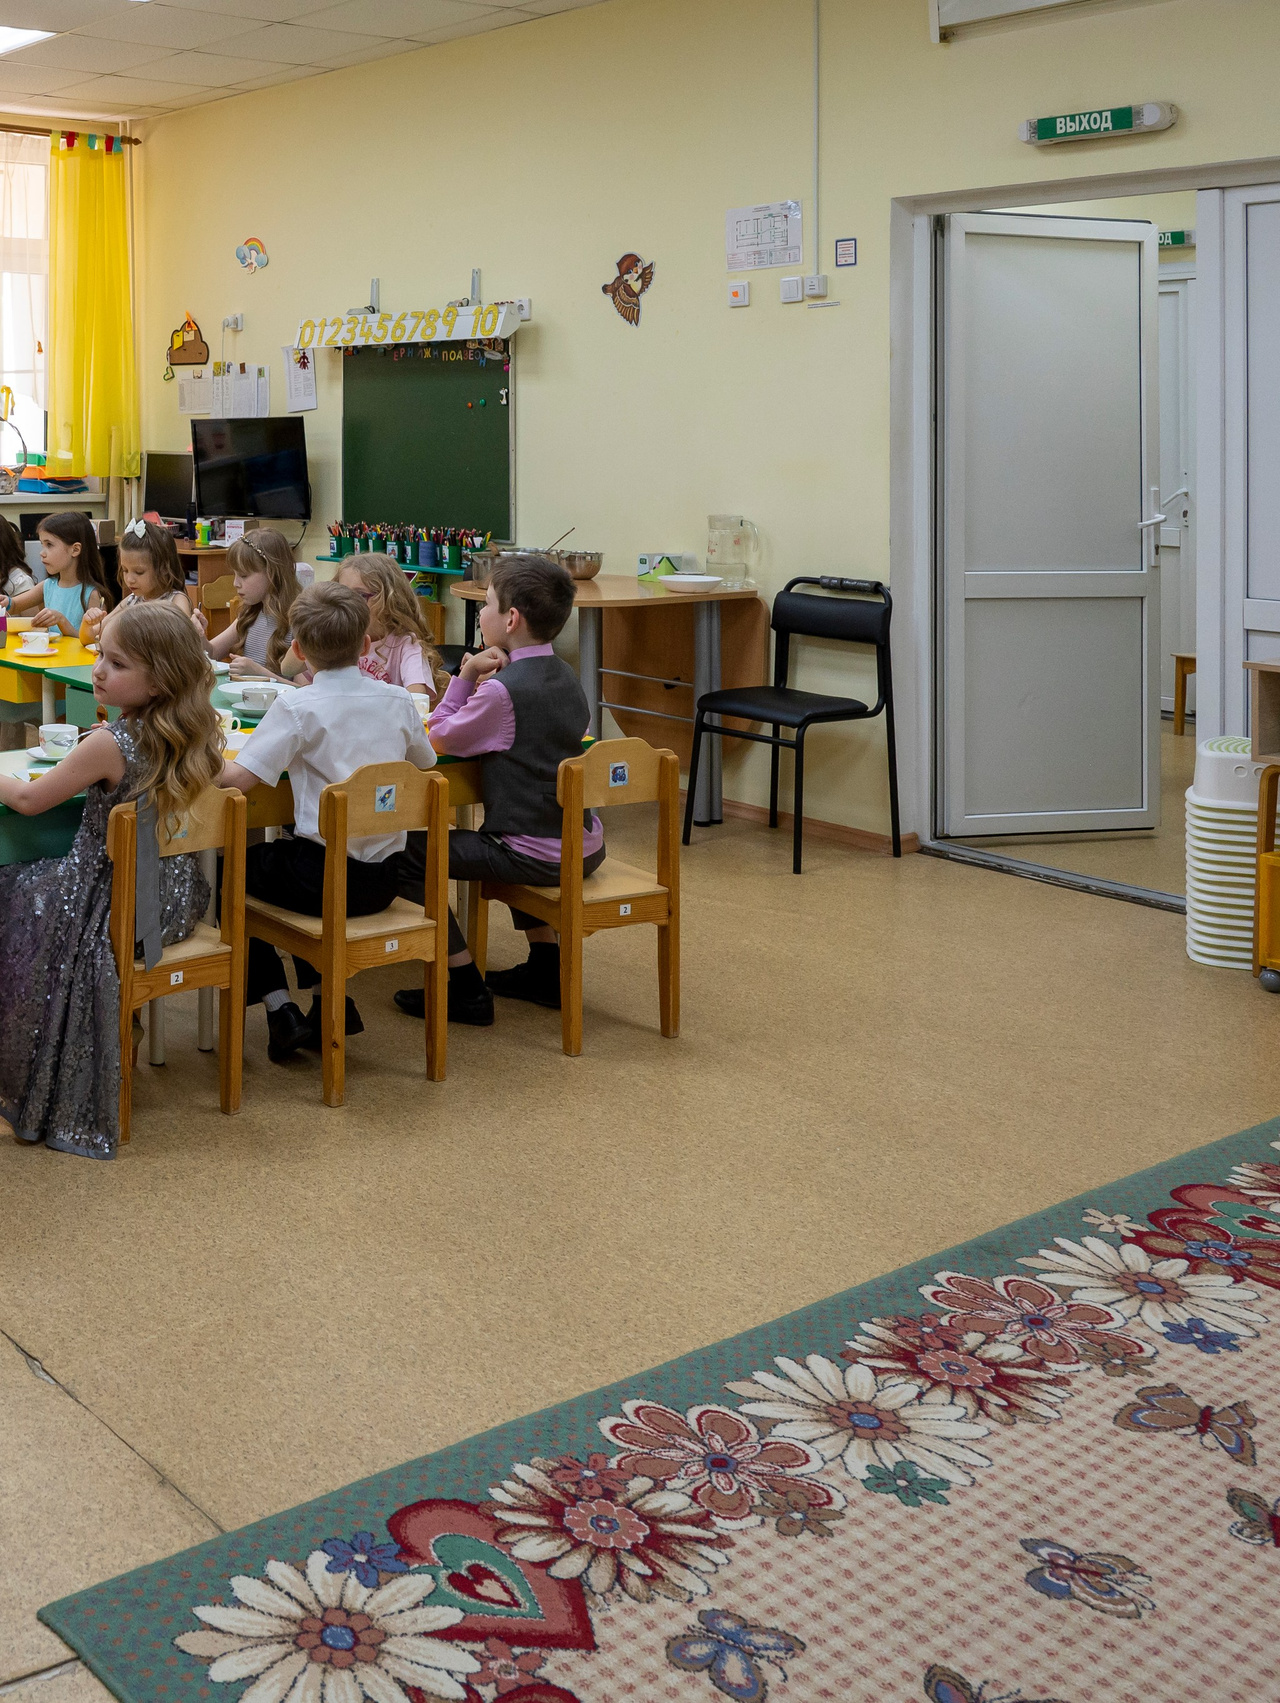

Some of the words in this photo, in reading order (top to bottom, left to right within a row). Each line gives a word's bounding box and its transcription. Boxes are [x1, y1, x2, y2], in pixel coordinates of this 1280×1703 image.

[1056, 111, 1113, 134] ВЫХОД
[623, 906, 628, 914] 2
[389, 942, 394, 950] 3
[174, 974, 180, 983] 2
